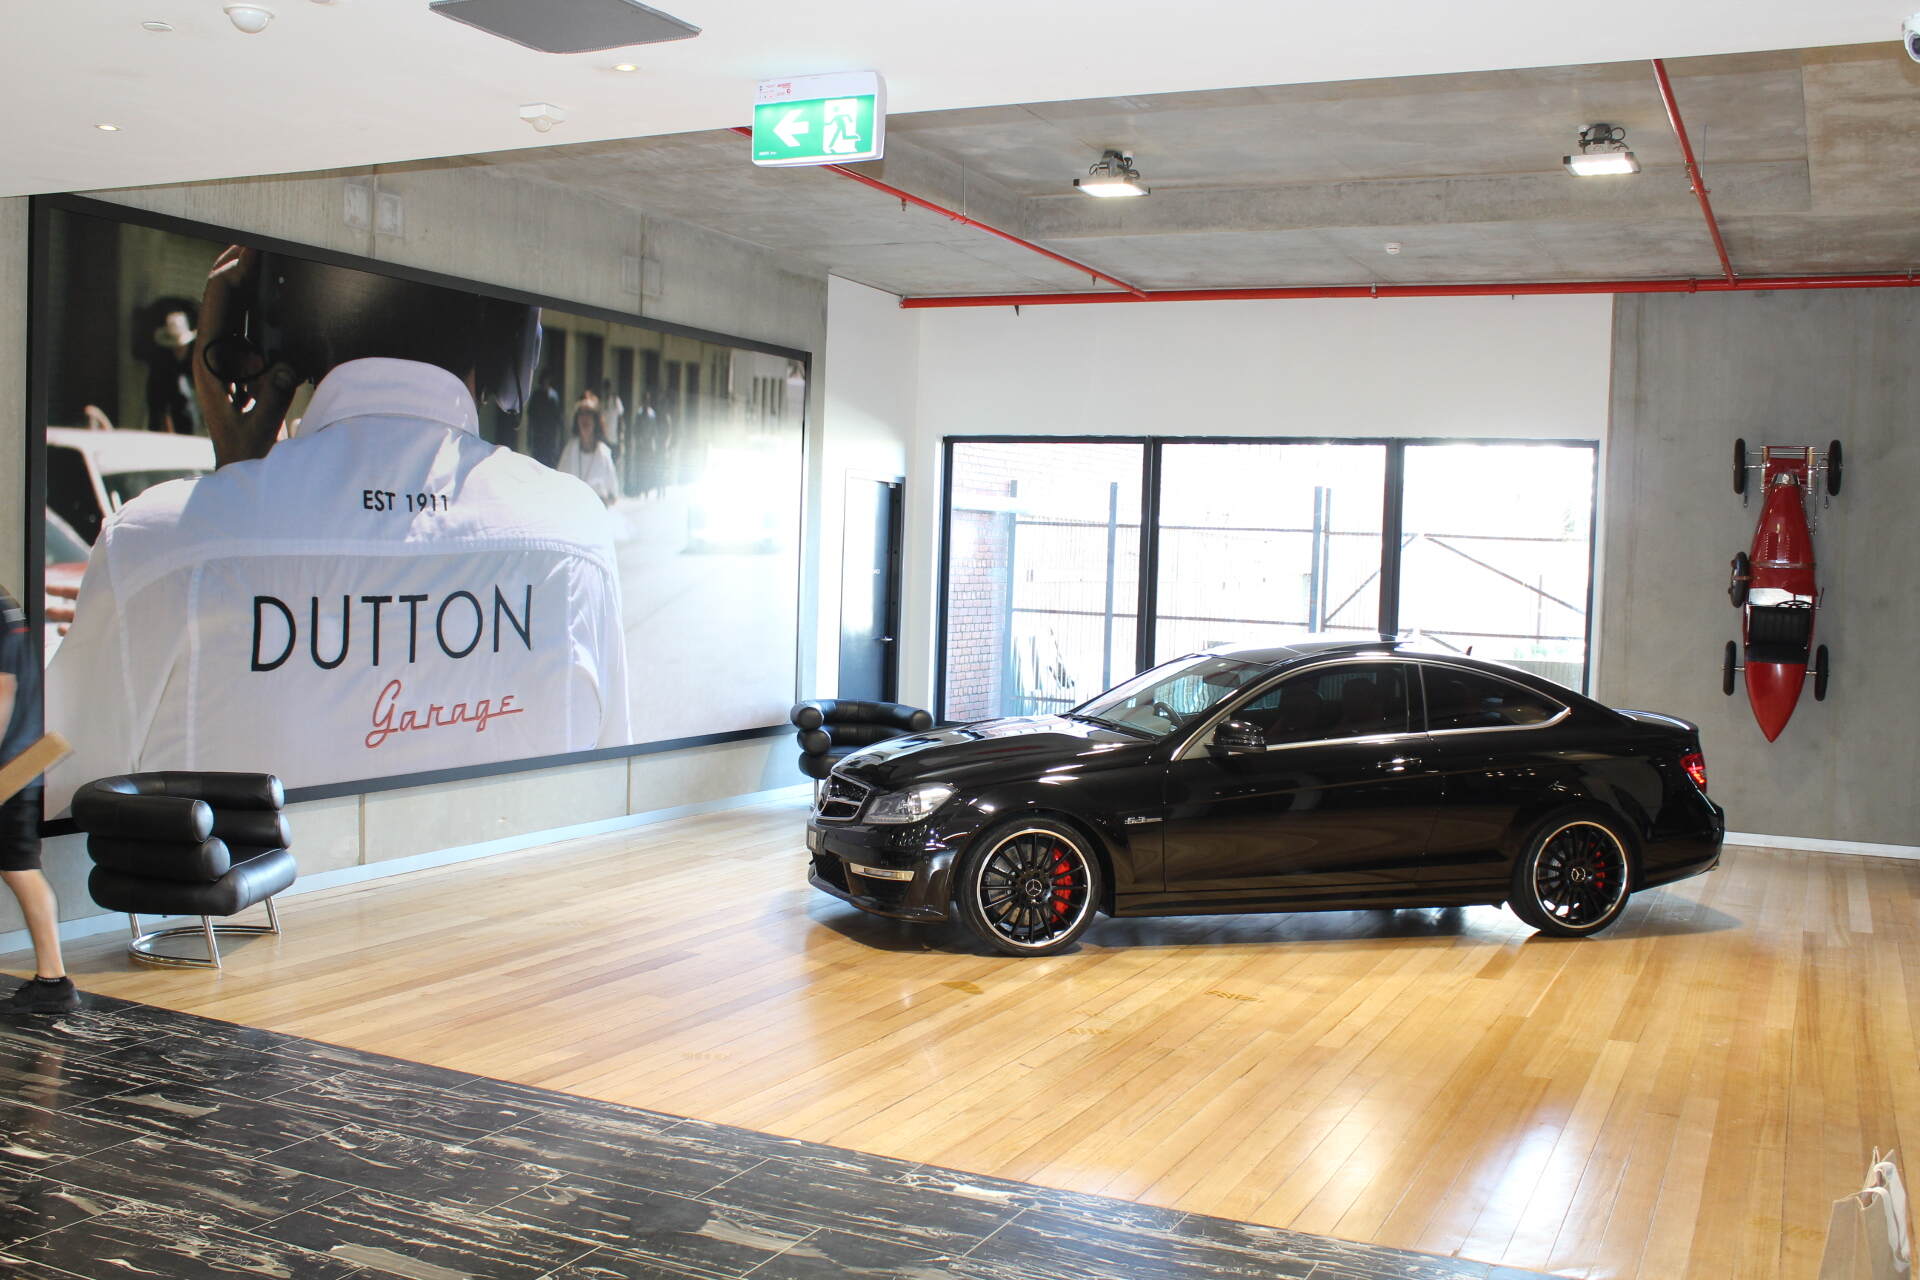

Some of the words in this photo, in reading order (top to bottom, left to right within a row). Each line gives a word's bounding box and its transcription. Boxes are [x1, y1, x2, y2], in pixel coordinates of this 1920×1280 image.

[363, 489, 396, 512] EST
[405, 492, 448, 513] 1911
[251, 583, 532, 672] DUTTON
[364, 679, 524, 749] Garage
